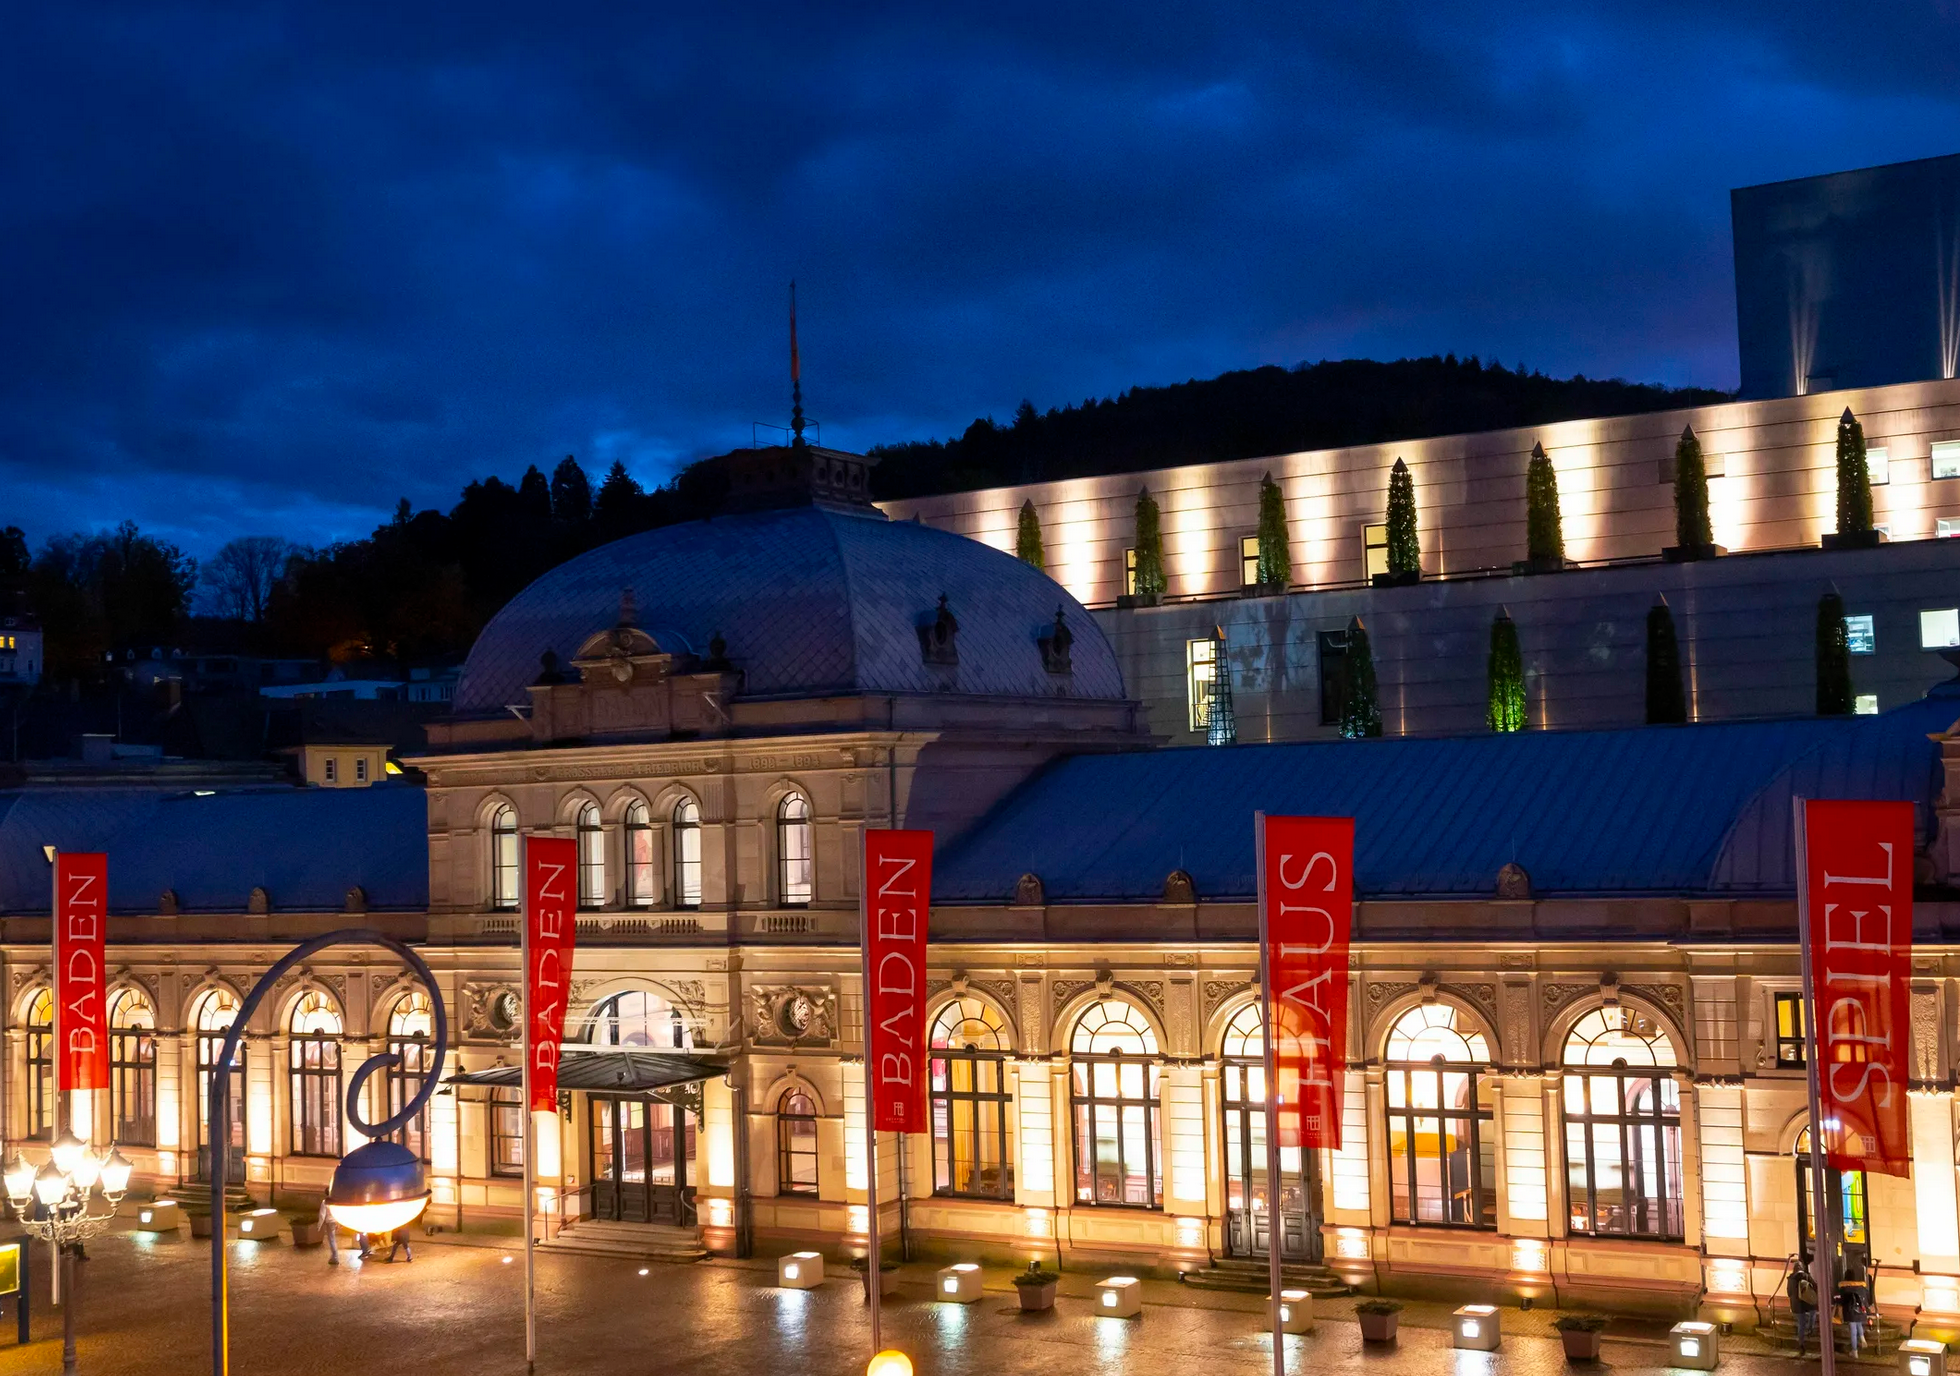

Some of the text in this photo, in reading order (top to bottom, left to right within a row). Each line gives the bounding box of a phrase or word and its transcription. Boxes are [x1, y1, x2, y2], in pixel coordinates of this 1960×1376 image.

[637, 759, 702, 776] FRIEDRICH
[68, 872, 98, 1054] BADEN
[536, 860, 566, 1073] BADEN
[878, 853, 917, 1088] BADEN
[1279, 851, 1337, 1088] HAUS
[1824, 842, 1893, 1108] SPIEL
